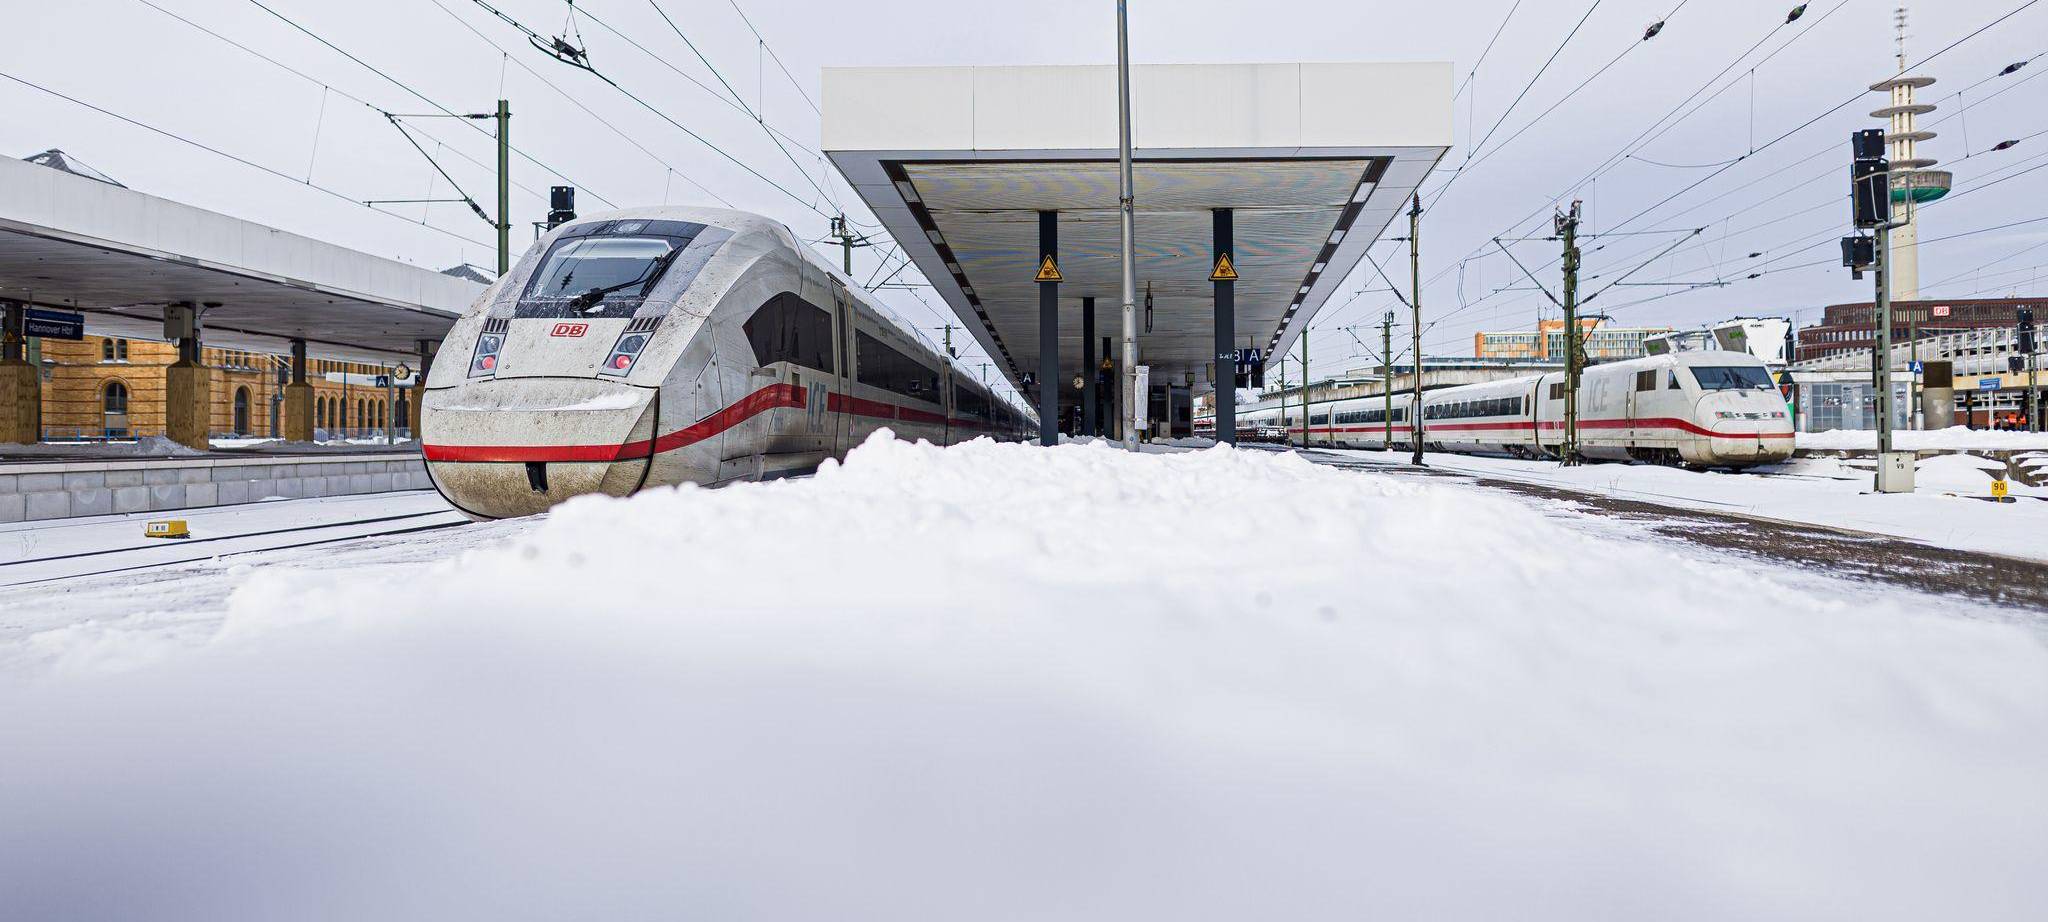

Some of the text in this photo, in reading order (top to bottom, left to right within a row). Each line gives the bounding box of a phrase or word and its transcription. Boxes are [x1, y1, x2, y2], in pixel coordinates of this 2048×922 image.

[1935, 306, 1948, 315] DB
[29, 322, 60, 335] Hannover
[555, 325, 584, 335] DB
[1250, 349, 1260, 362] A
[1914, 361, 1922, 372] A
[377, 377, 387, 387] A
[1023, 371, 1032, 383] A
[1588, 377, 1610, 413] ICE
[807, 381, 827, 434] ICE
[1994, 482, 2005, 491] 90
